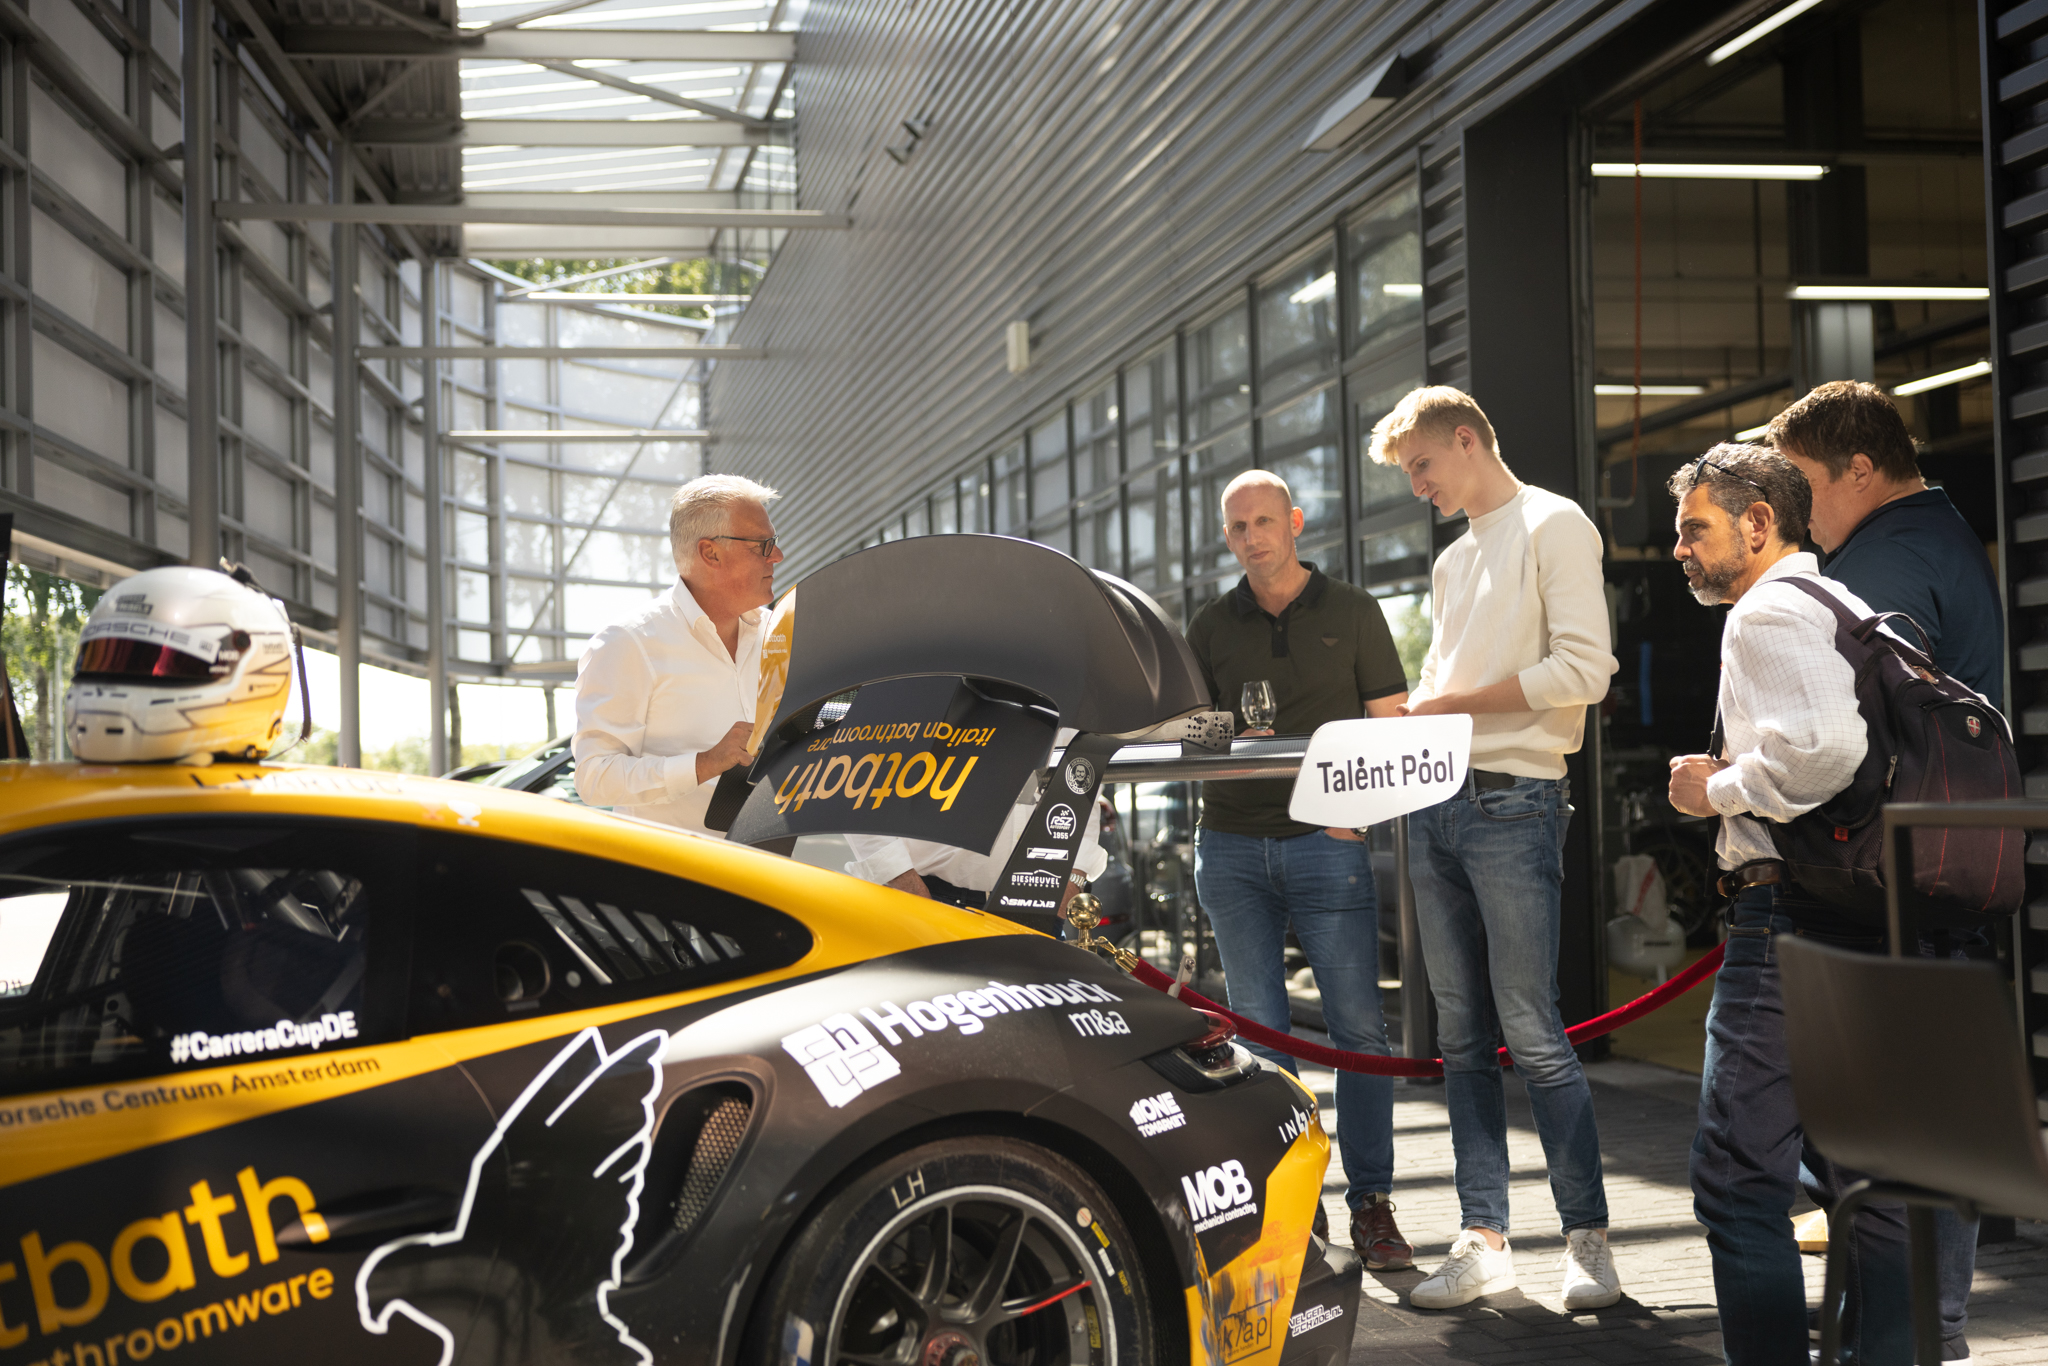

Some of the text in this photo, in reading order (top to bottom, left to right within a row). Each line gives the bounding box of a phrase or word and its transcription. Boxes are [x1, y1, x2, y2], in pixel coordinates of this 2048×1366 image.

[807, 722, 997, 753] italian bathroomare
[774, 751, 979, 815] hotbath
[1316, 751, 1454, 793] Talent Pool
[1050, 815, 1073, 826] RSZ
[1052, 831, 1069, 840] 1955
[1011, 875, 1060, 885] BIESHEUVEL
[859, 979, 1123, 1046] Hogenhouck
[1068, 1008, 1131, 1037] m&a
[170, 1011, 358, 1063] #CarreraCupDE
[103, 1080, 224, 1112] Centrum
[230, 1057, 381, 1095] Amsterdam
[1181, 1159, 1253, 1222] MOB
[1193, 1202, 1258, 1233] mechanical contracting
